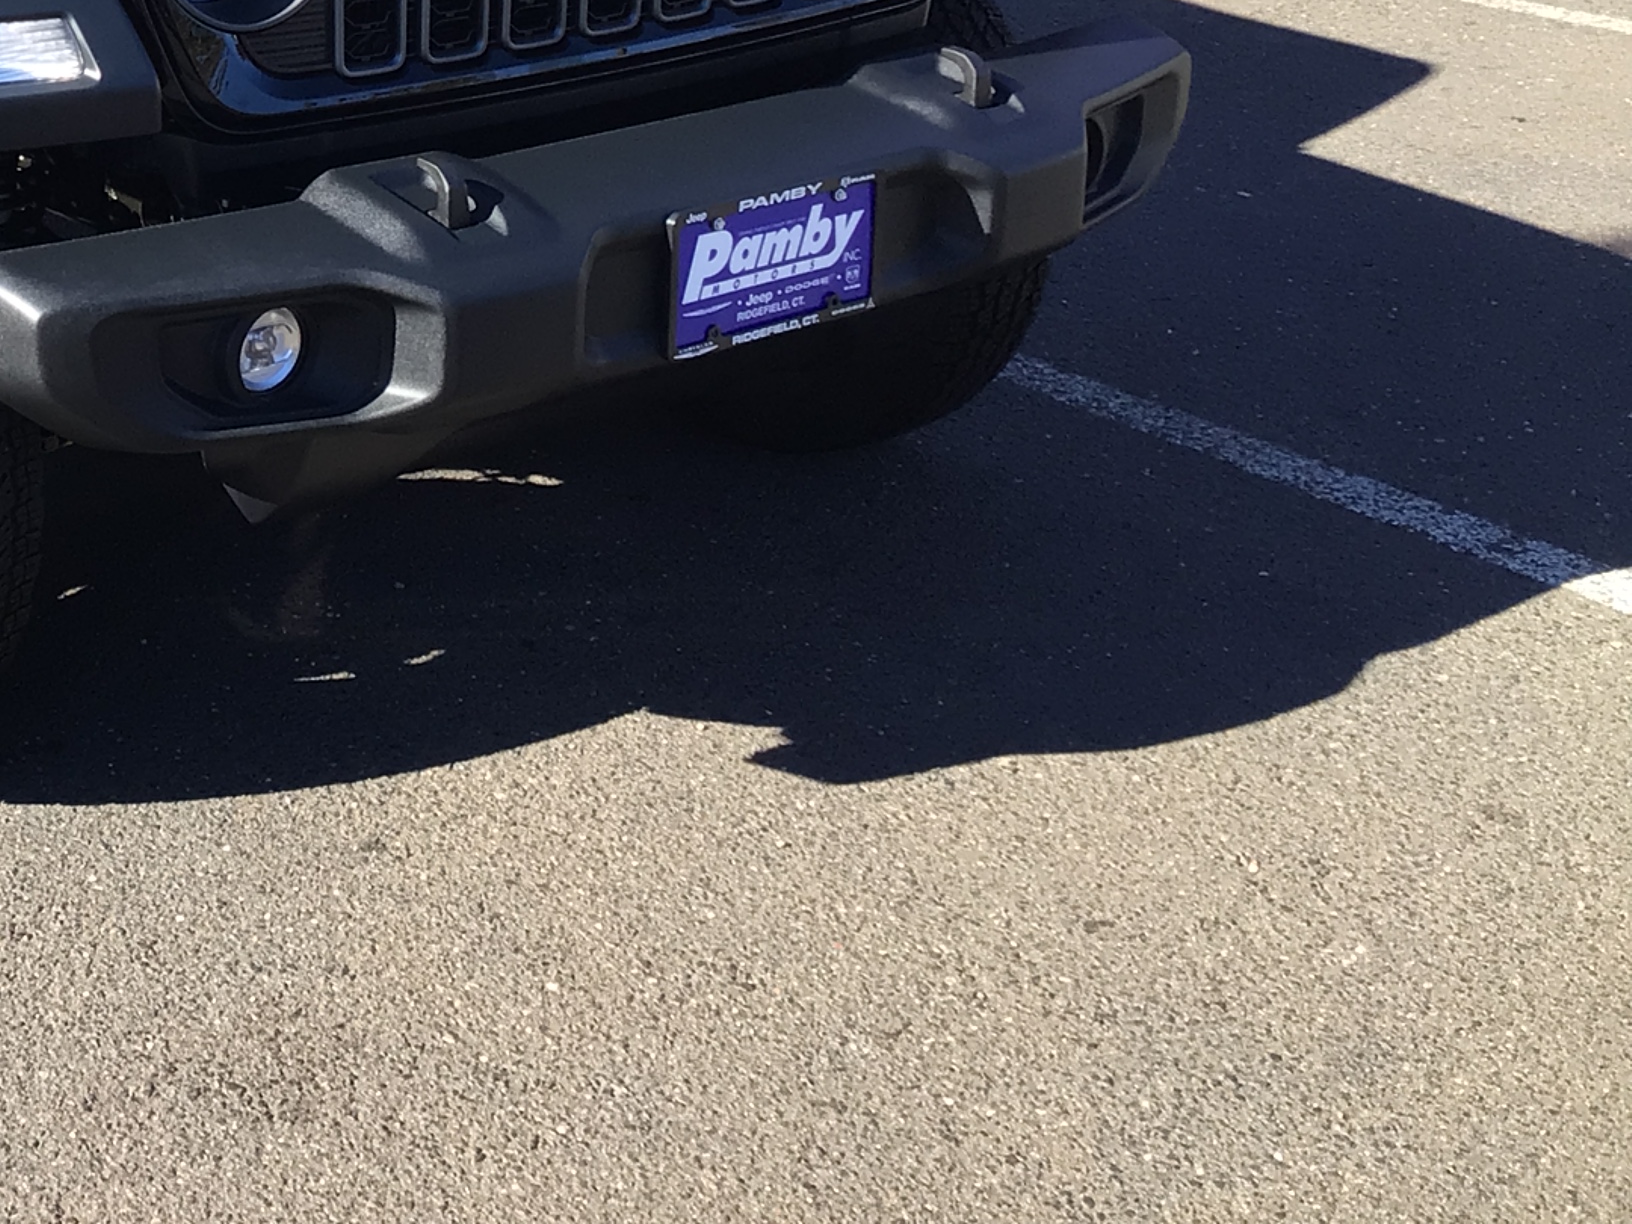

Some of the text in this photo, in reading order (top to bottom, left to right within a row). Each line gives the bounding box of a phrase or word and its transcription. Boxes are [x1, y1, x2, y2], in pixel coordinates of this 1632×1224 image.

[738, 182, 823, 213] PAMBY
[681, 204, 865, 305] Pamby
[745, 291, 774, 307] Jeep
